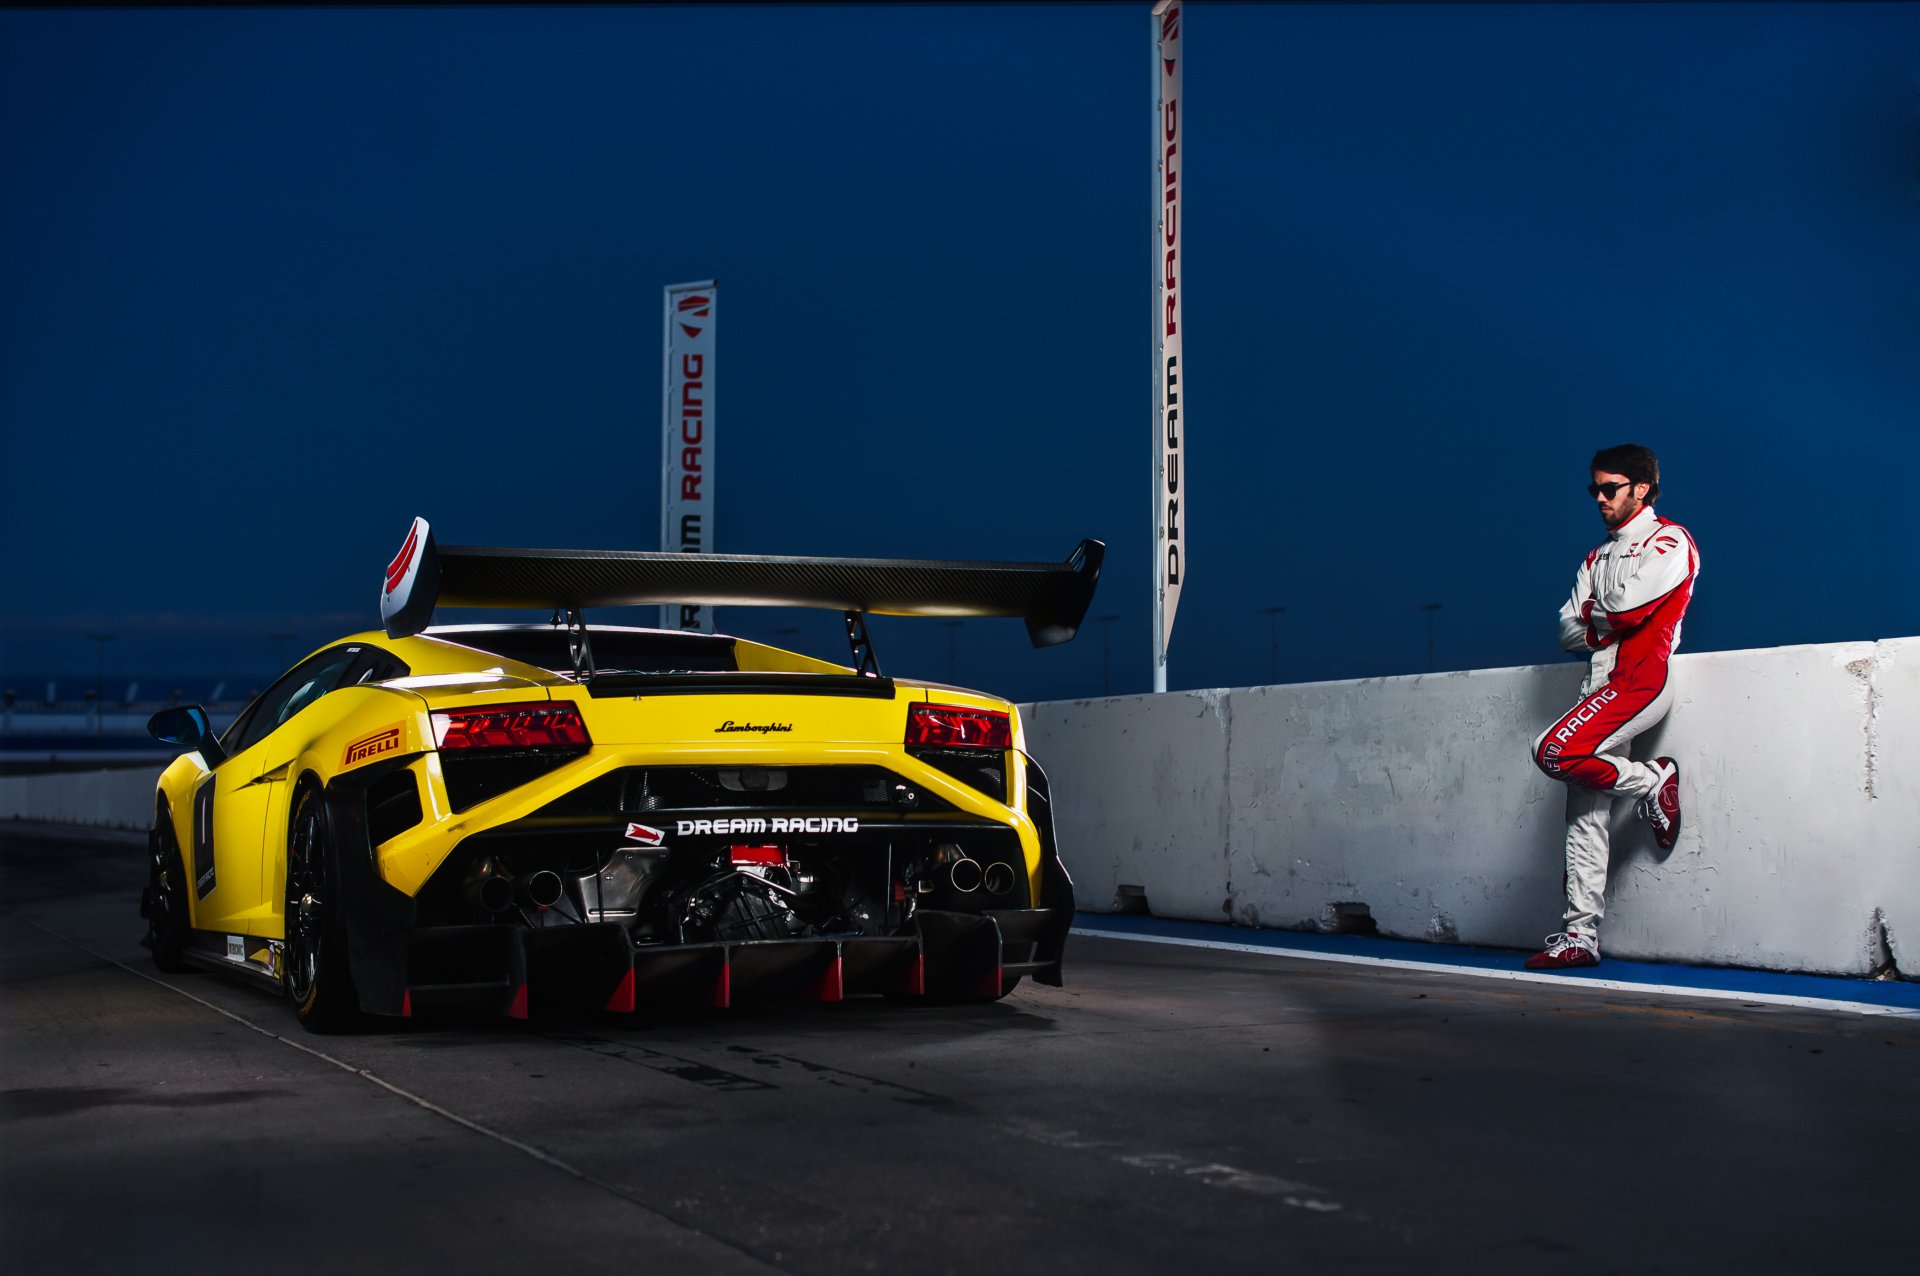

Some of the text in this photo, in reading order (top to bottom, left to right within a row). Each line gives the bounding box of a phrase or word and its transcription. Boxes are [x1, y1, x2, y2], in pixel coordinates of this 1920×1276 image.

[1165, 99, 1179, 588] DREAM RACING
[681, 354, 704, 501] RACING
[714, 720, 793, 735] Lamborghini
[1555, 688, 1619, 743] RACING
[345, 728, 399, 765] PIRELLI
[676, 817, 859, 836] DREAM RACING
